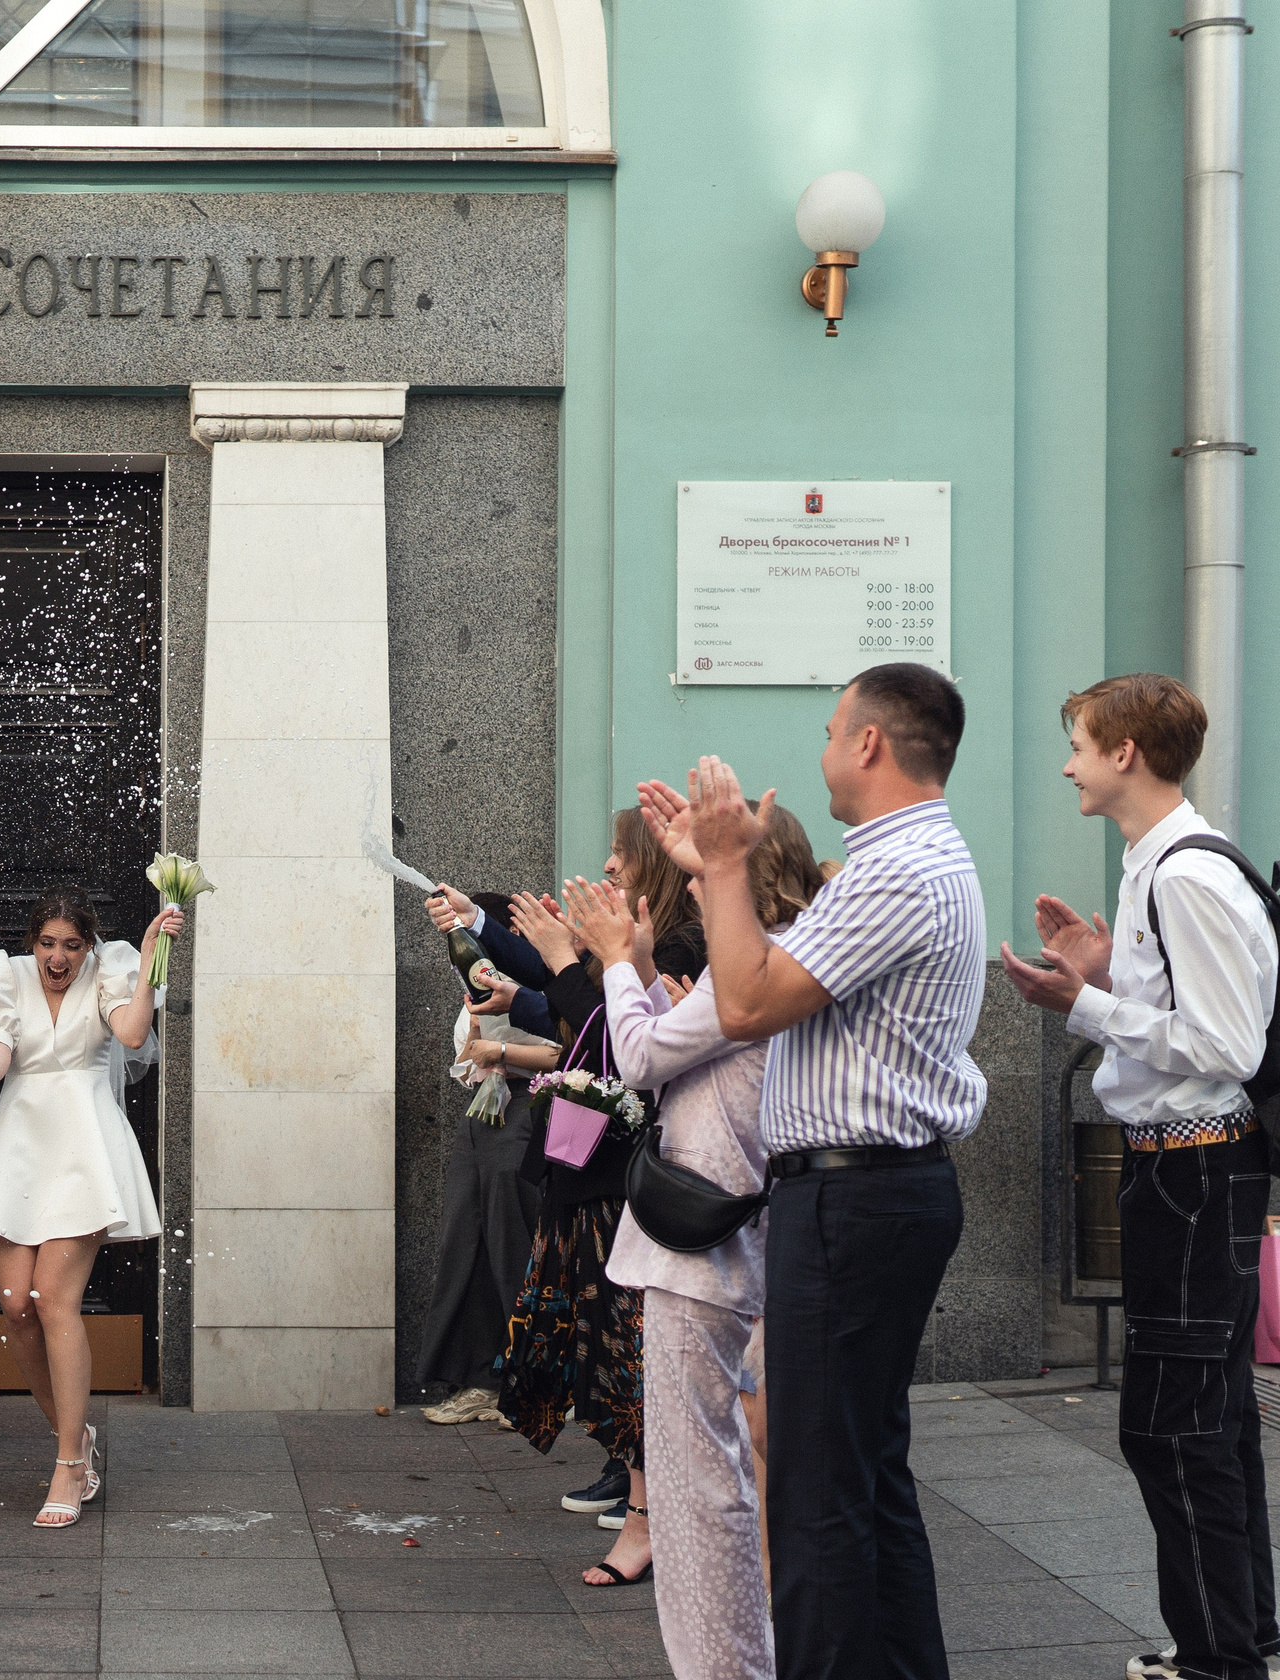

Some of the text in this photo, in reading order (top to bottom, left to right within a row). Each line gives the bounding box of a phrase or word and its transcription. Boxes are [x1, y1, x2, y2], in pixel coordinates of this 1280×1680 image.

[719, 535, 910, 549] Дворец бракосочетания № 1
[768, 566, 860, 577] РЕЖИМ РАБОТЫ
[866, 583, 892, 594] 9:00
[904, 583, 934, 594] 18:00
[694, 604, 721, 612] ПЯТНИЦА
[866, 600, 892, 611] 9:00
[902, 600, 934, 611] 20:00
[866, 618, 892, 629] 9:00
[902, 618, 934, 629] 23:59
[859, 635, 892, 646] 00:00
[904, 635, 934, 646] 19:00
